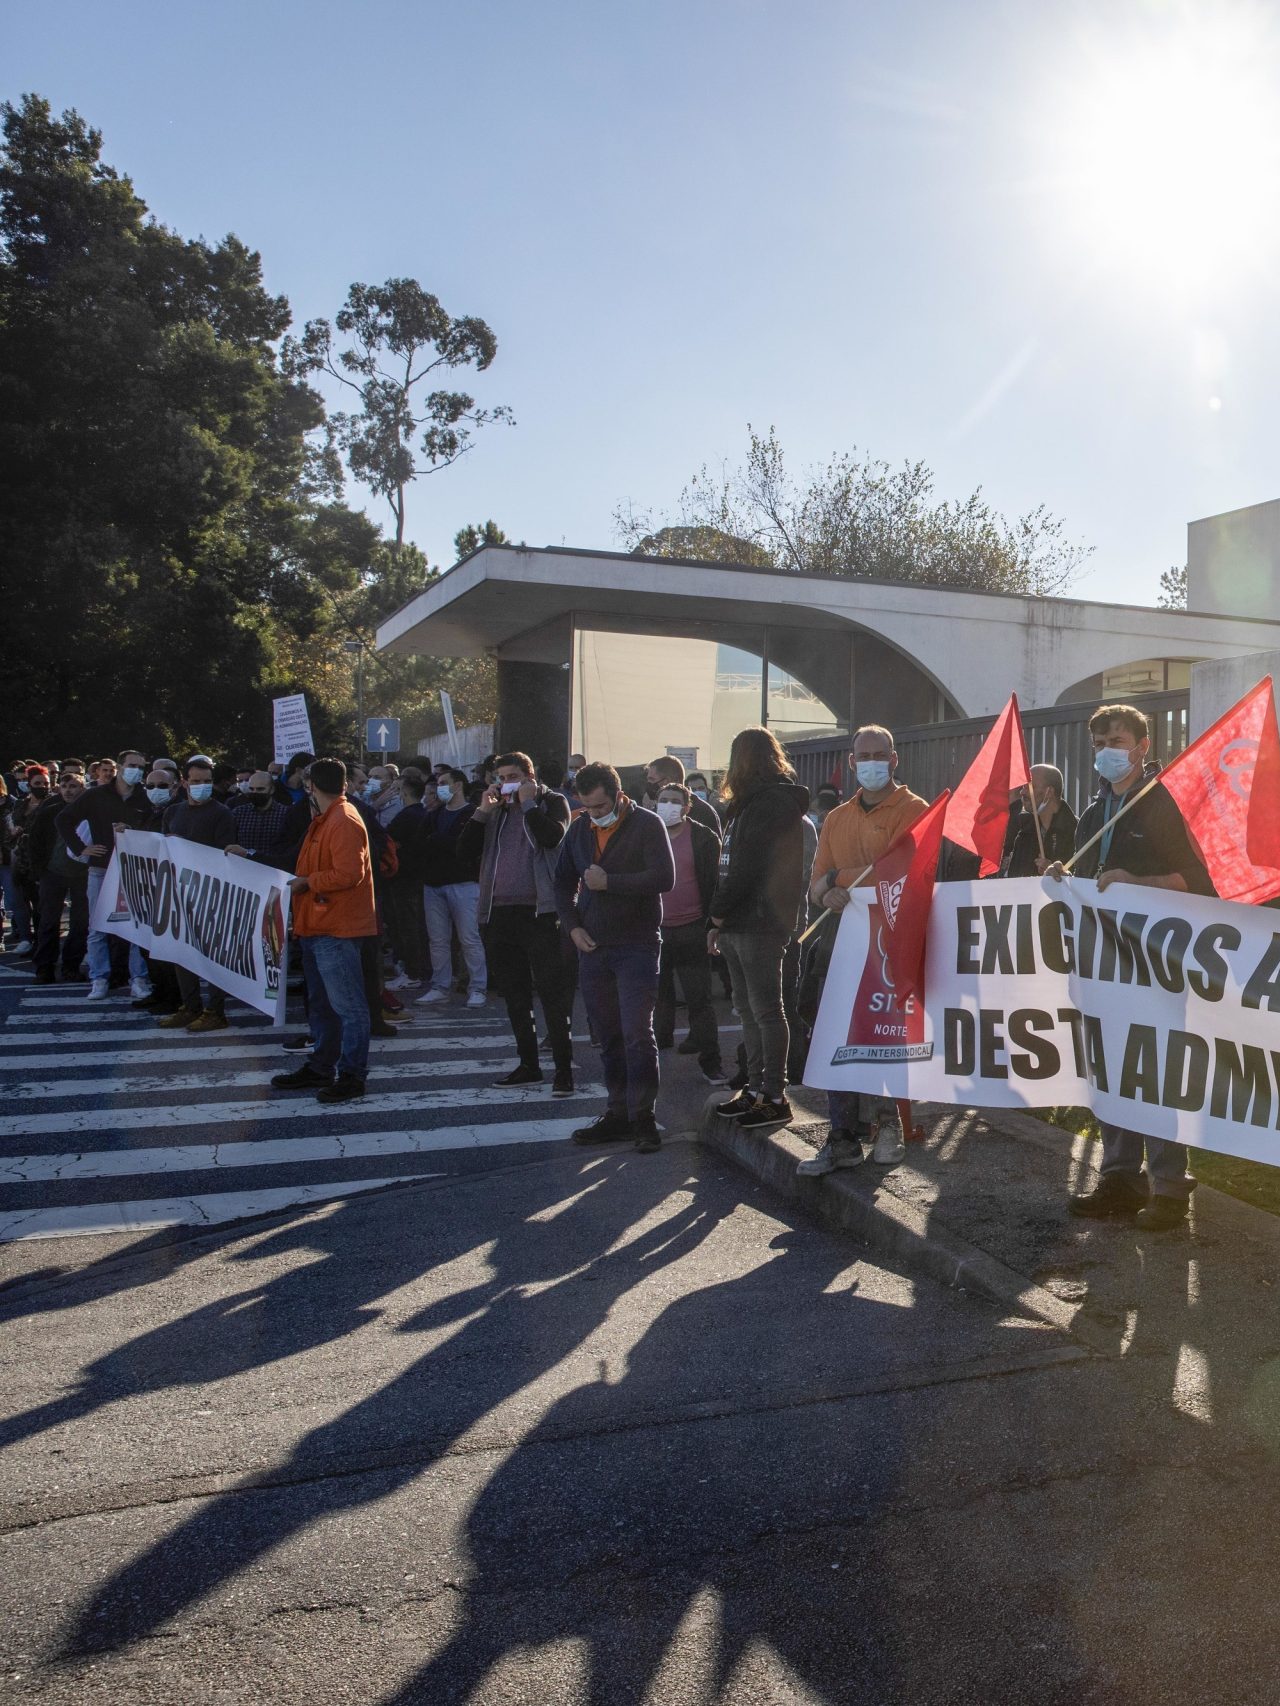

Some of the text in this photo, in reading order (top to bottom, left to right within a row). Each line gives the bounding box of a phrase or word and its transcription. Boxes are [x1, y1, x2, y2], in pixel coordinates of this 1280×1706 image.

[179, 867, 261, 981] TRABALHAR
[956, 900, 1242, 1003] EXIGIMOS
[837, 1048, 858, 1059] CGTP
[868, 1046, 931, 1058] INTERSINDICAL
[874, 1023, 908, 1037] NORTE
[943, 1007, 1110, 1094] DESTA
